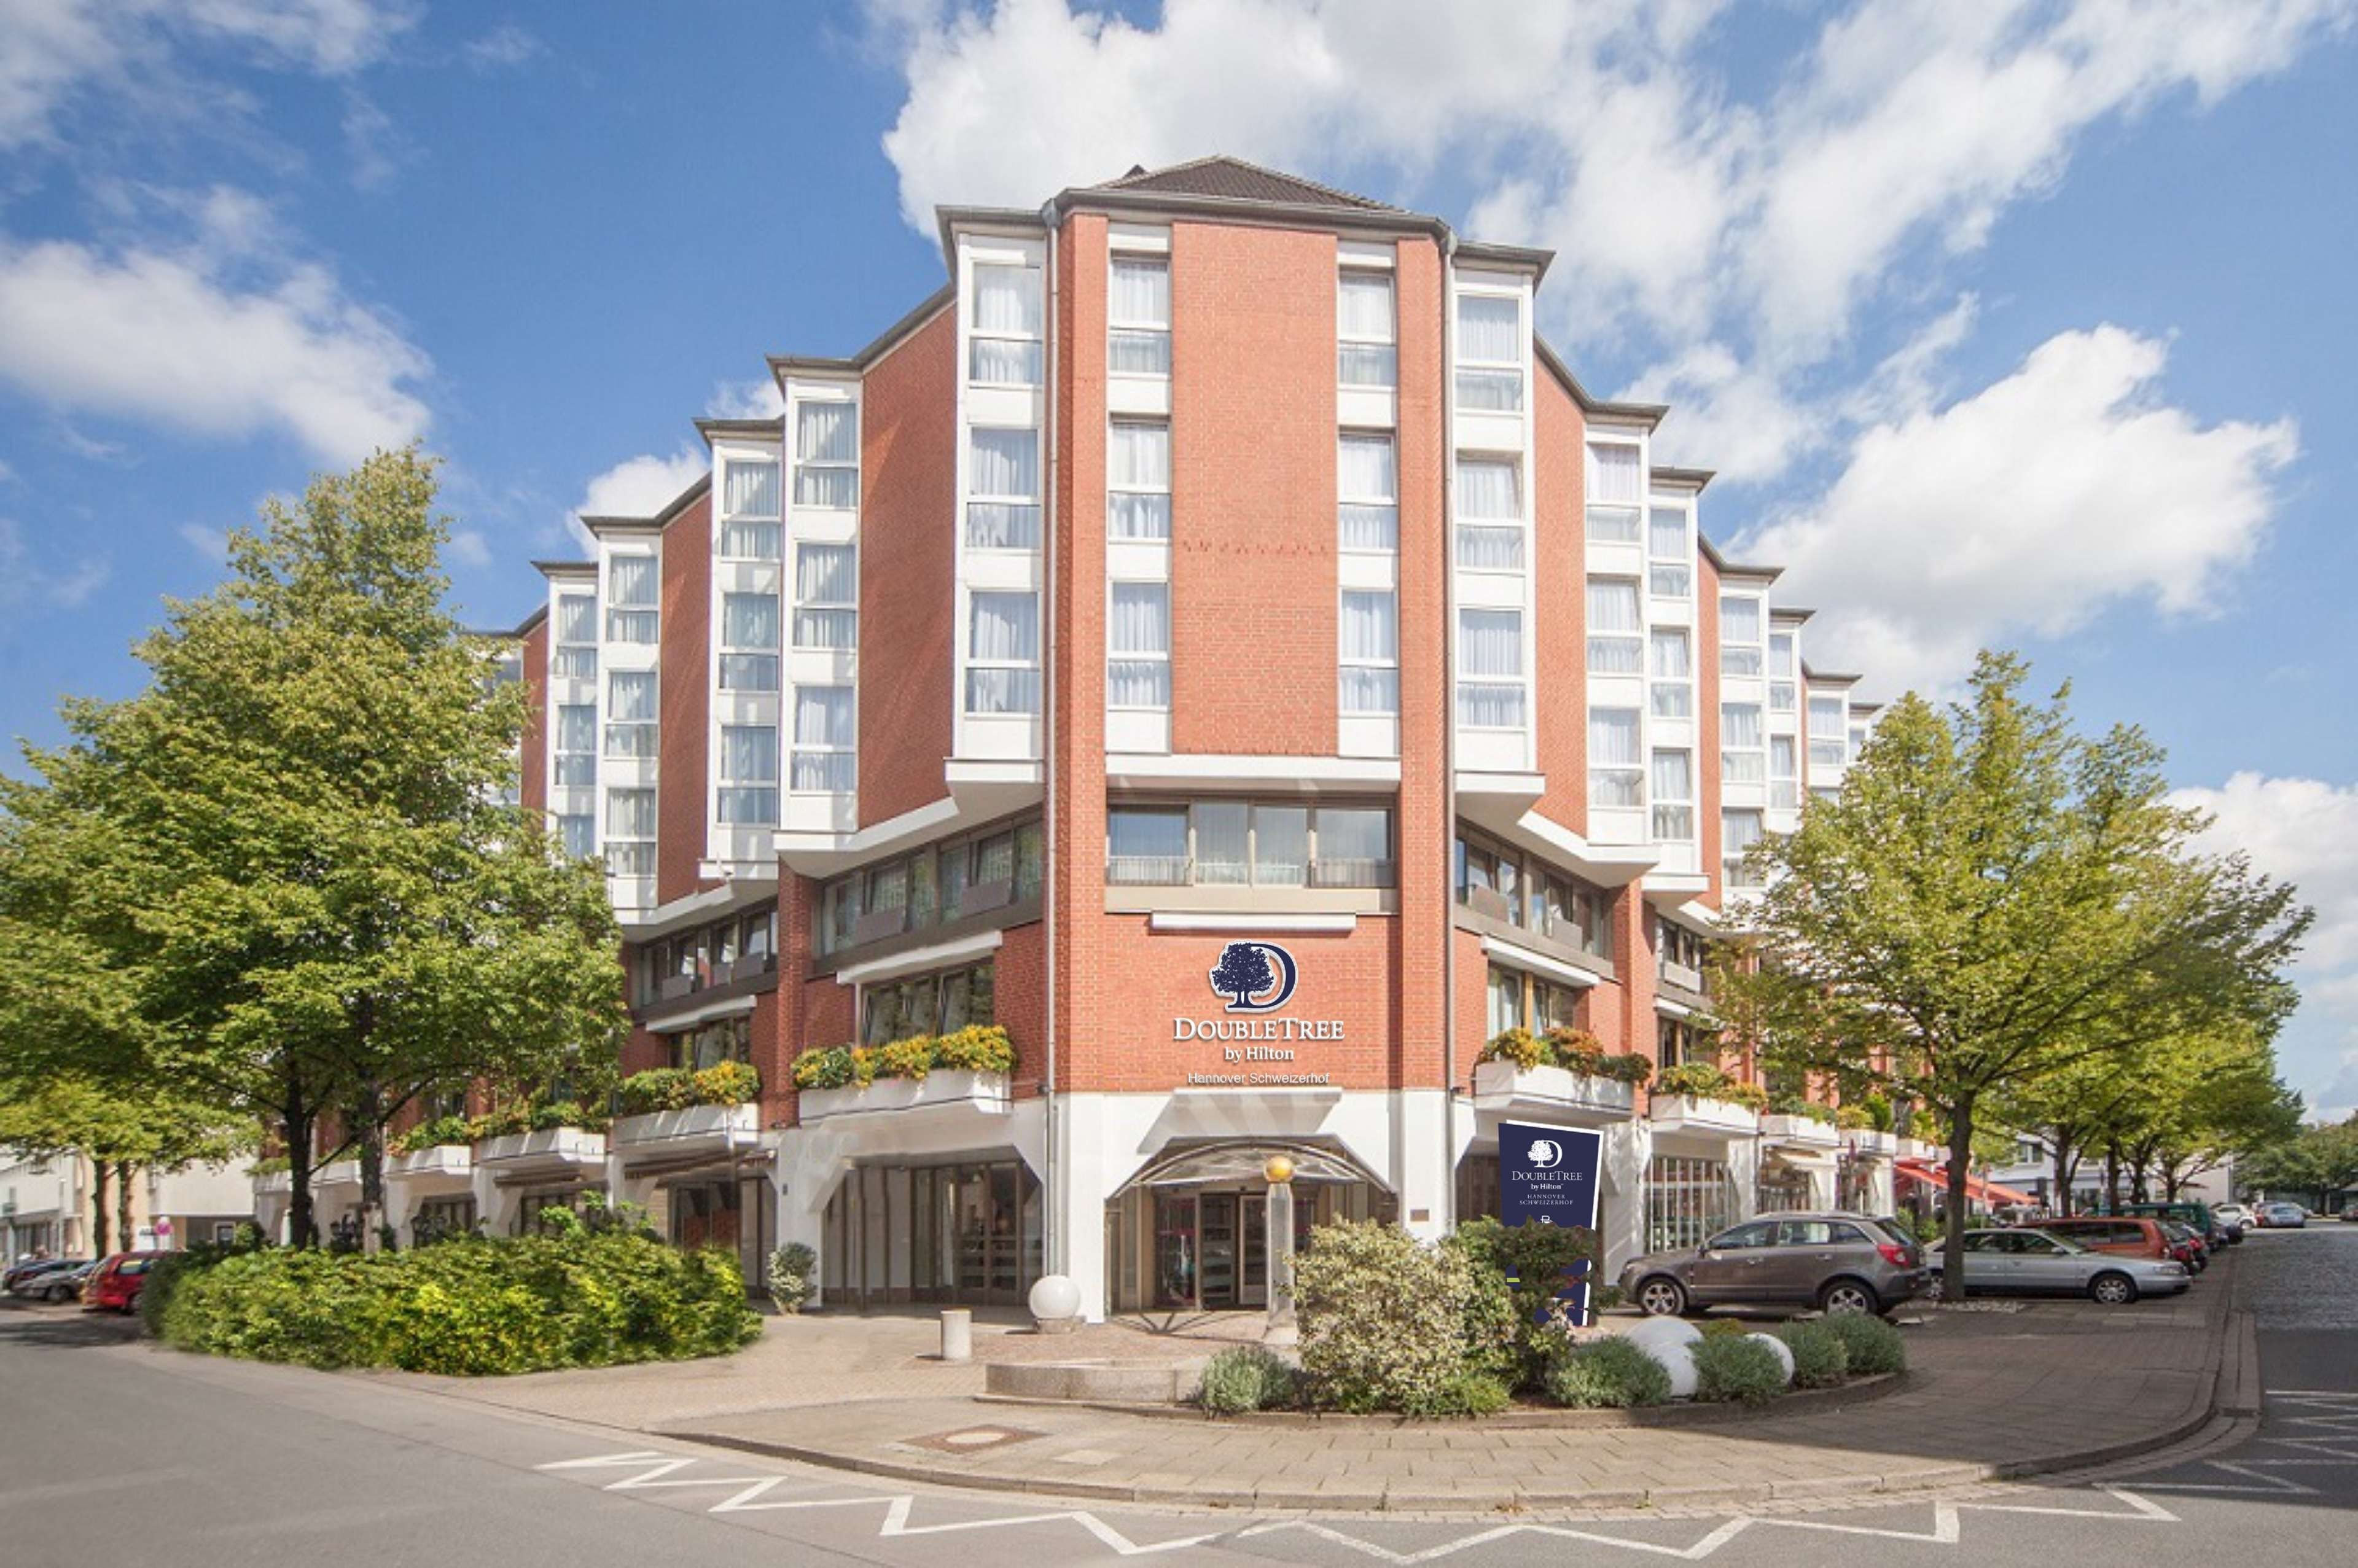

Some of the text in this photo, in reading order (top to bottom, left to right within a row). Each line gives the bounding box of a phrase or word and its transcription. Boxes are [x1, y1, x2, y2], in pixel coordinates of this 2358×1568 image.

[1173, 1017, 1346, 1040] DOUBLETREE
[1224, 1047, 1295, 1063] by Hilton
[1188, 1072, 1330, 1083] Hannover Schweizerhof
[1512, 1171, 1583, 1180] DOUBLETREE
